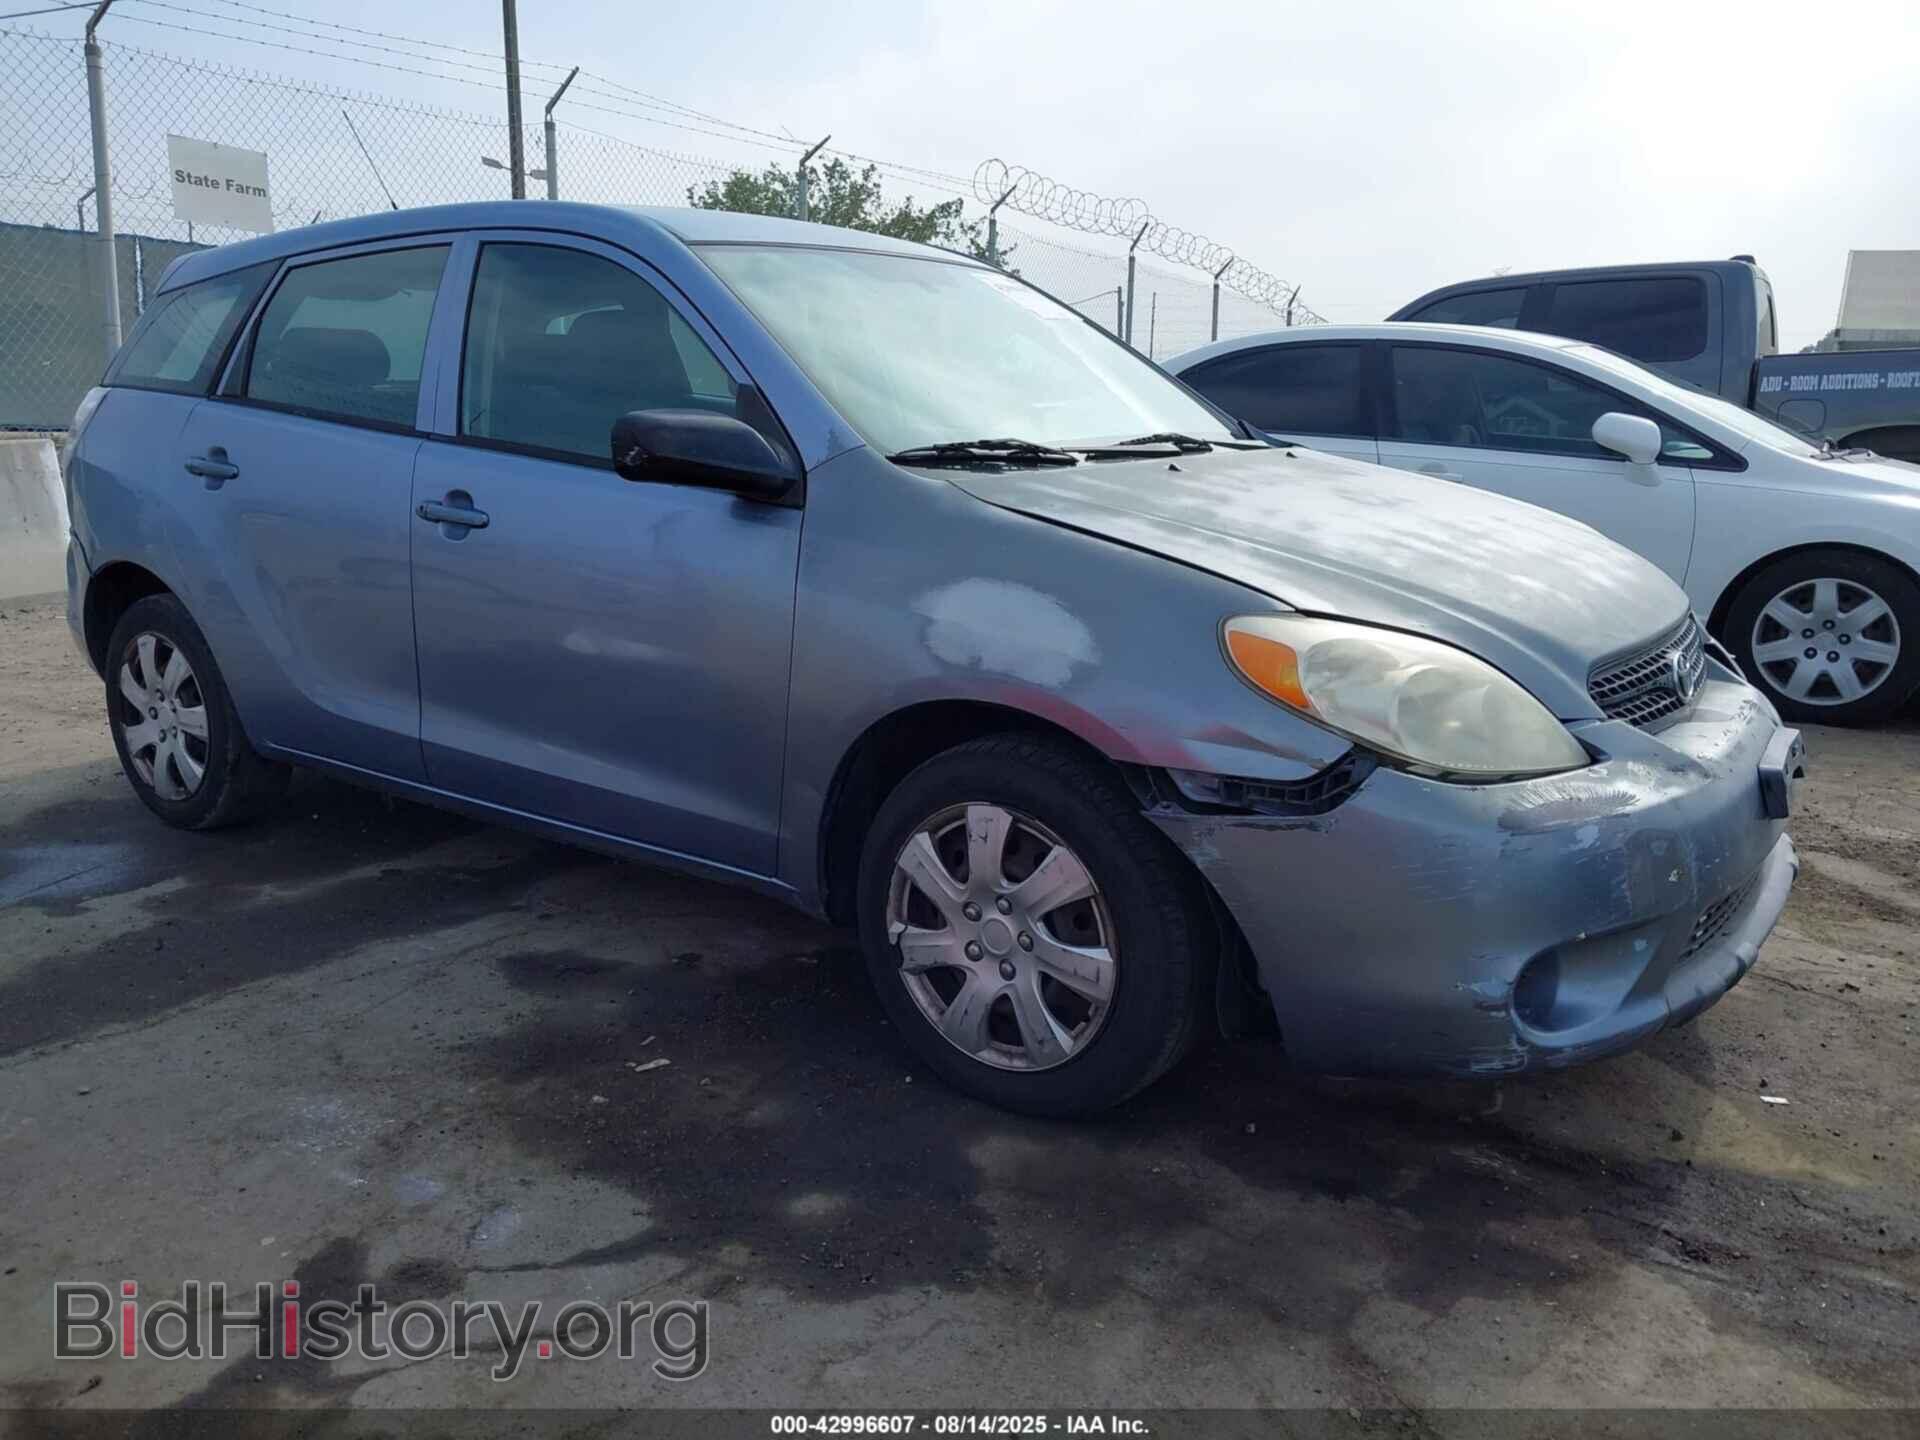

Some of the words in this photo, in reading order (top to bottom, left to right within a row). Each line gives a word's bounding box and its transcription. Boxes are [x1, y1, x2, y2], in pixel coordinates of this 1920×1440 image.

[174, 169, 221, 190] State
[225, 178, 267, 198] Farm
[1760, 376, 1783, 392] ADU
[1790, 375, 1819, 392] ROOM
[1820, 373, 1880, 390] ADDITIONS
